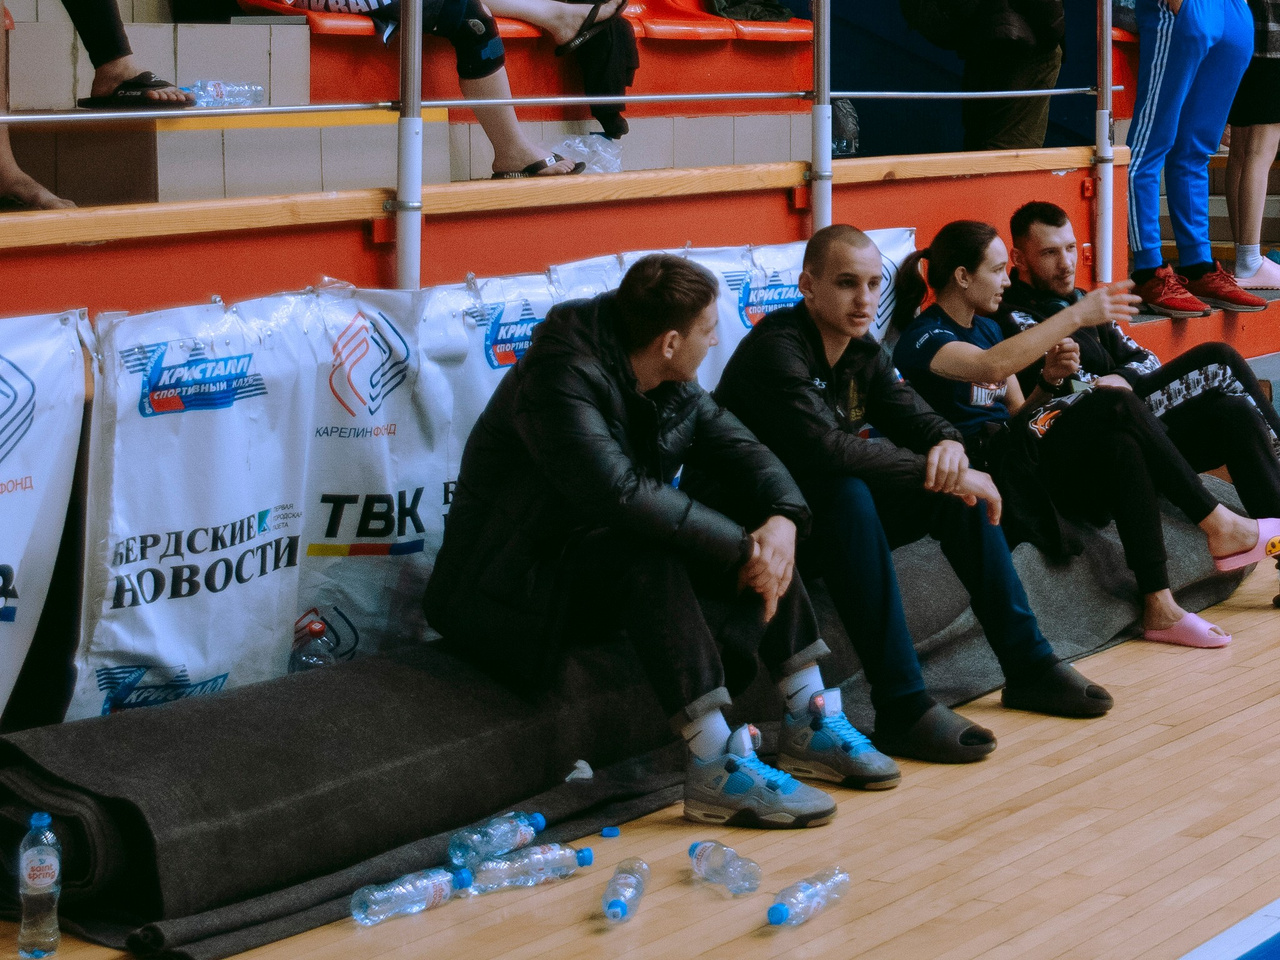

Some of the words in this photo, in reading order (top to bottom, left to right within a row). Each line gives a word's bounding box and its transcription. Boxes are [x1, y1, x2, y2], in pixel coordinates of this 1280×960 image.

[158, 355, 251, 387] КРИСТАЛЛ
[153, 381, 228, 400] СПОРТИВНЫЙ
[320, 486, 426, 539] ТВК
[111, 514, 257, 567] БЕРДСКИЕ
[109, 534, 301, 610] НОВОСТИ
[27, 870, 57, 881] spring
[30, 863, 54, 873] saint
